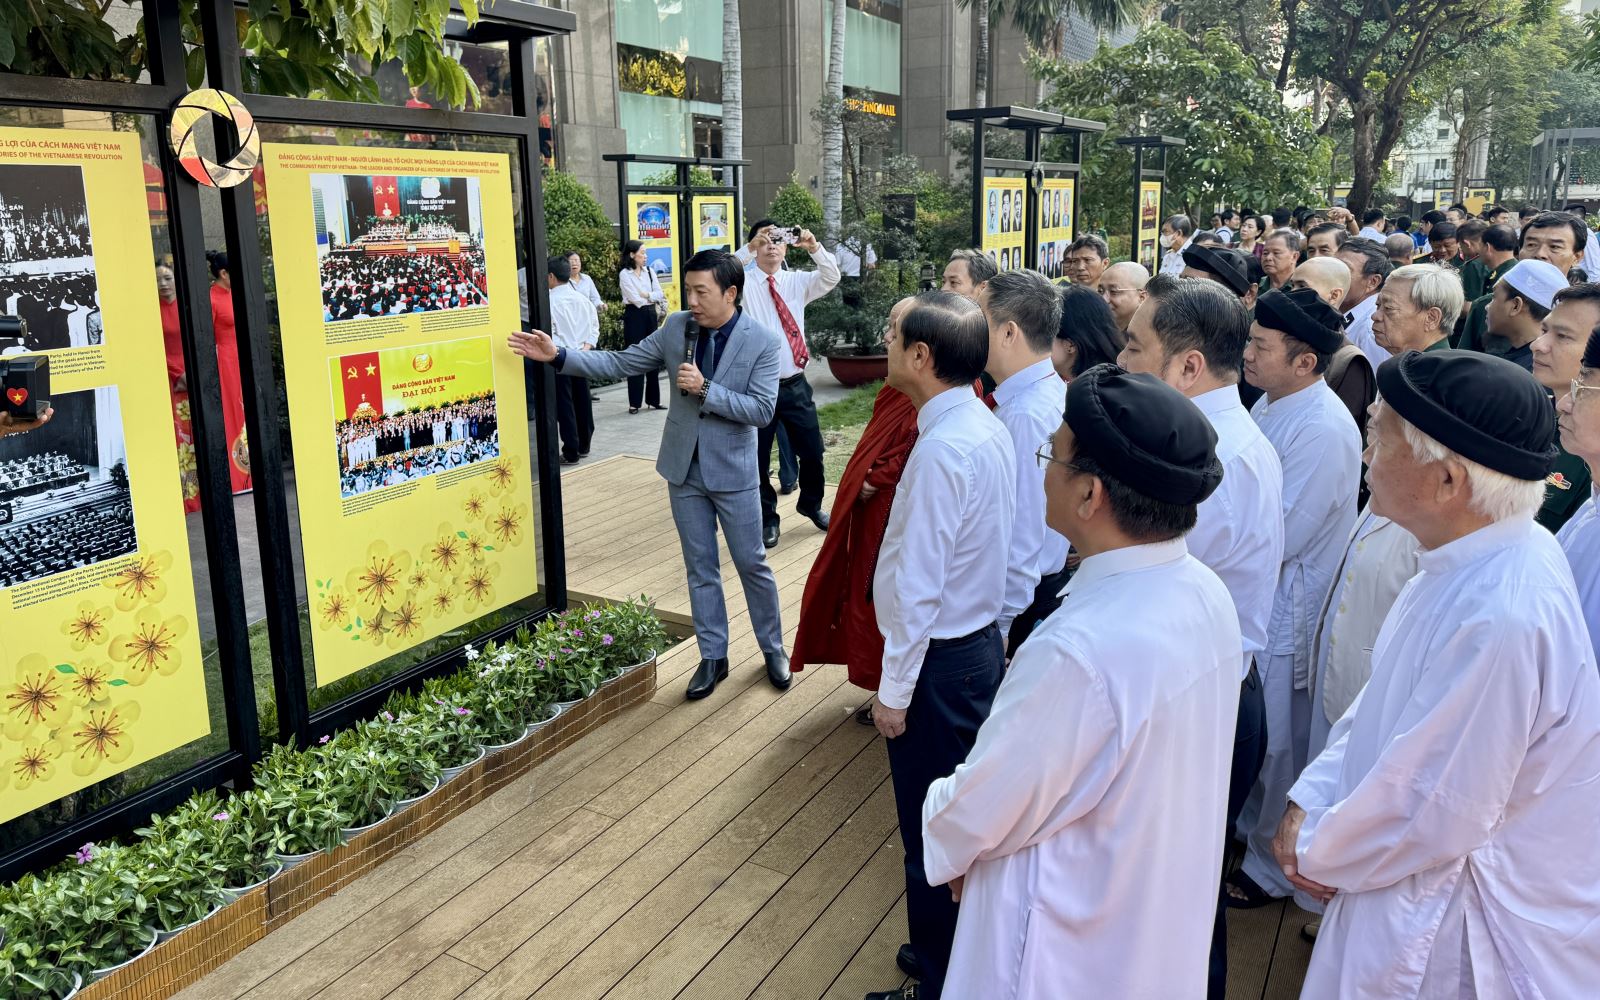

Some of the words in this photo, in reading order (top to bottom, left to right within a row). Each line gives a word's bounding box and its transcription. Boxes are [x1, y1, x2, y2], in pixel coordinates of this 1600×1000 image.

[5, 140, 18, 148] LỢI
[20, 139, 37, 148] CỦA
[38, 139, 60, 148] CÁCH
[62, 142, 85, 150] MẠNG
[86, 142, 102, 151] VIỆT
